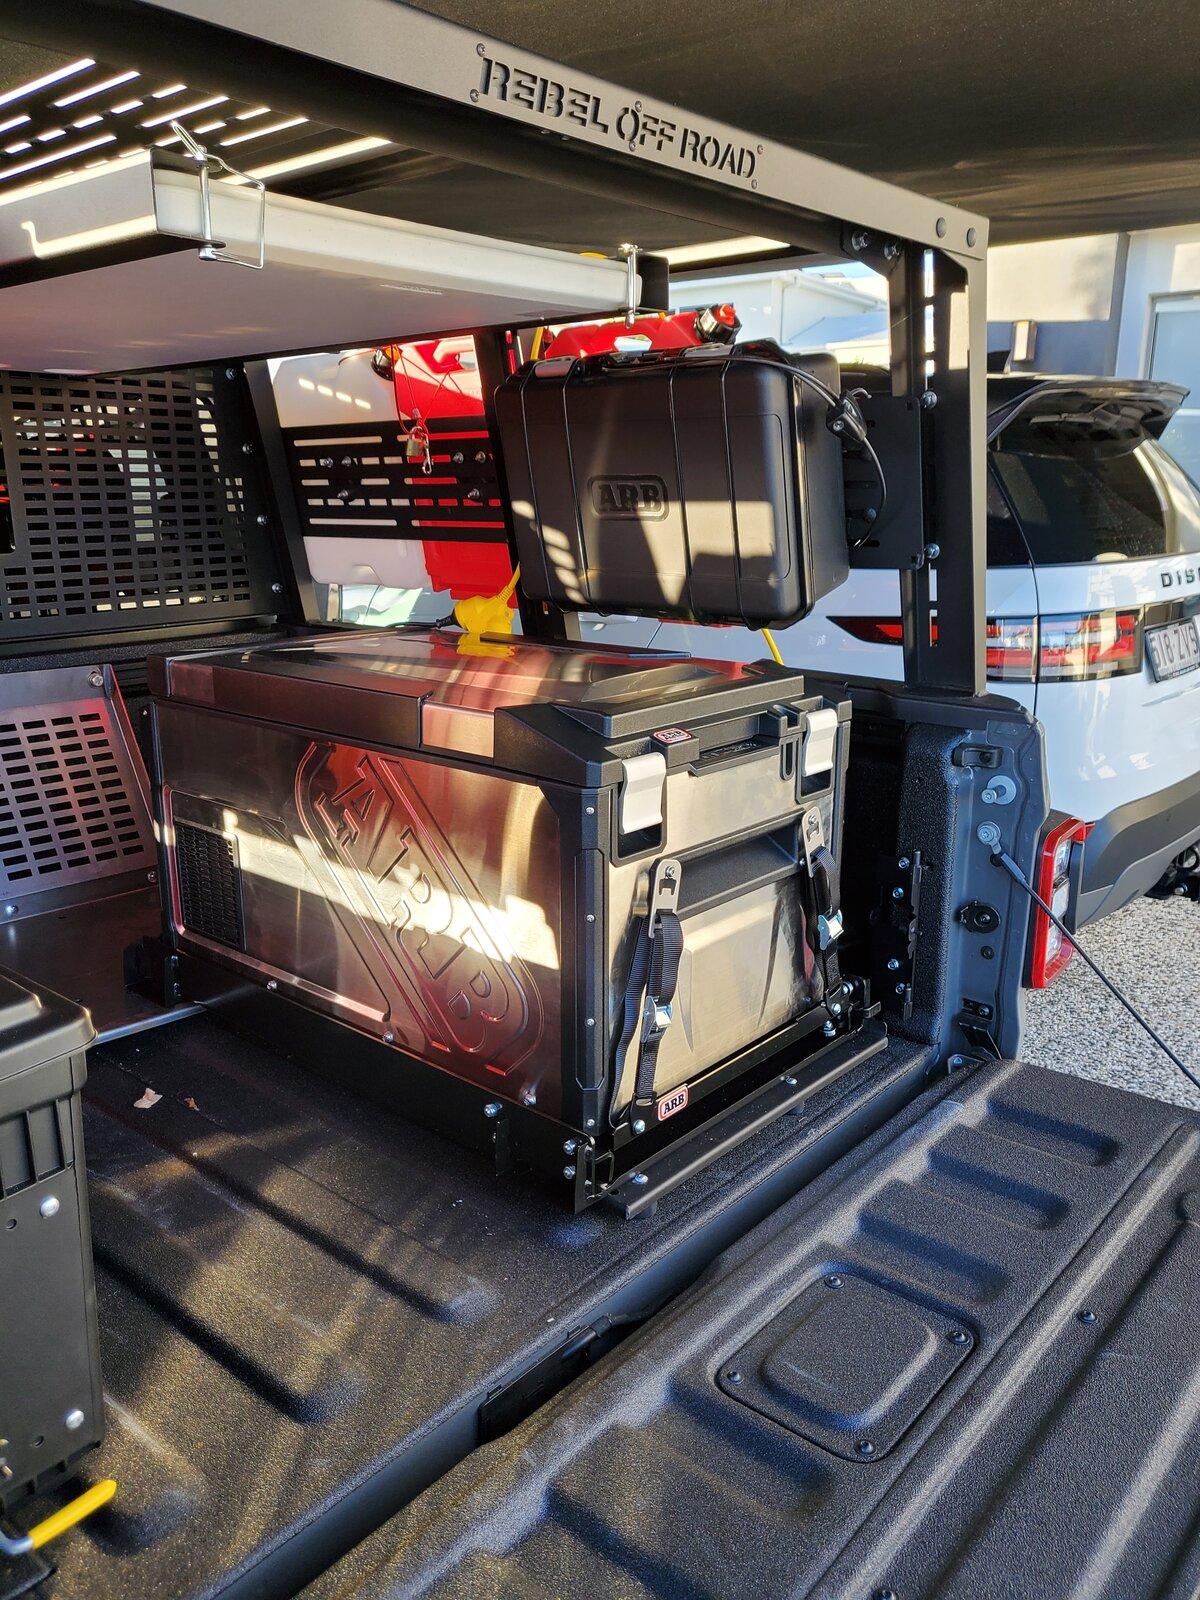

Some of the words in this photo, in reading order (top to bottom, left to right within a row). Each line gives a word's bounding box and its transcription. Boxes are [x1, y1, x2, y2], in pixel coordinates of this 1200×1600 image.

[479, 57, 609, 134] REBEL
[616, 107, 677, 151] OFF
[680, 127, 756, 179] ROAD
[598, 482, 660, 512] ARB
[314, 753, 510, 1053] ARB
[664, 1093, 685, 1115] ARB
